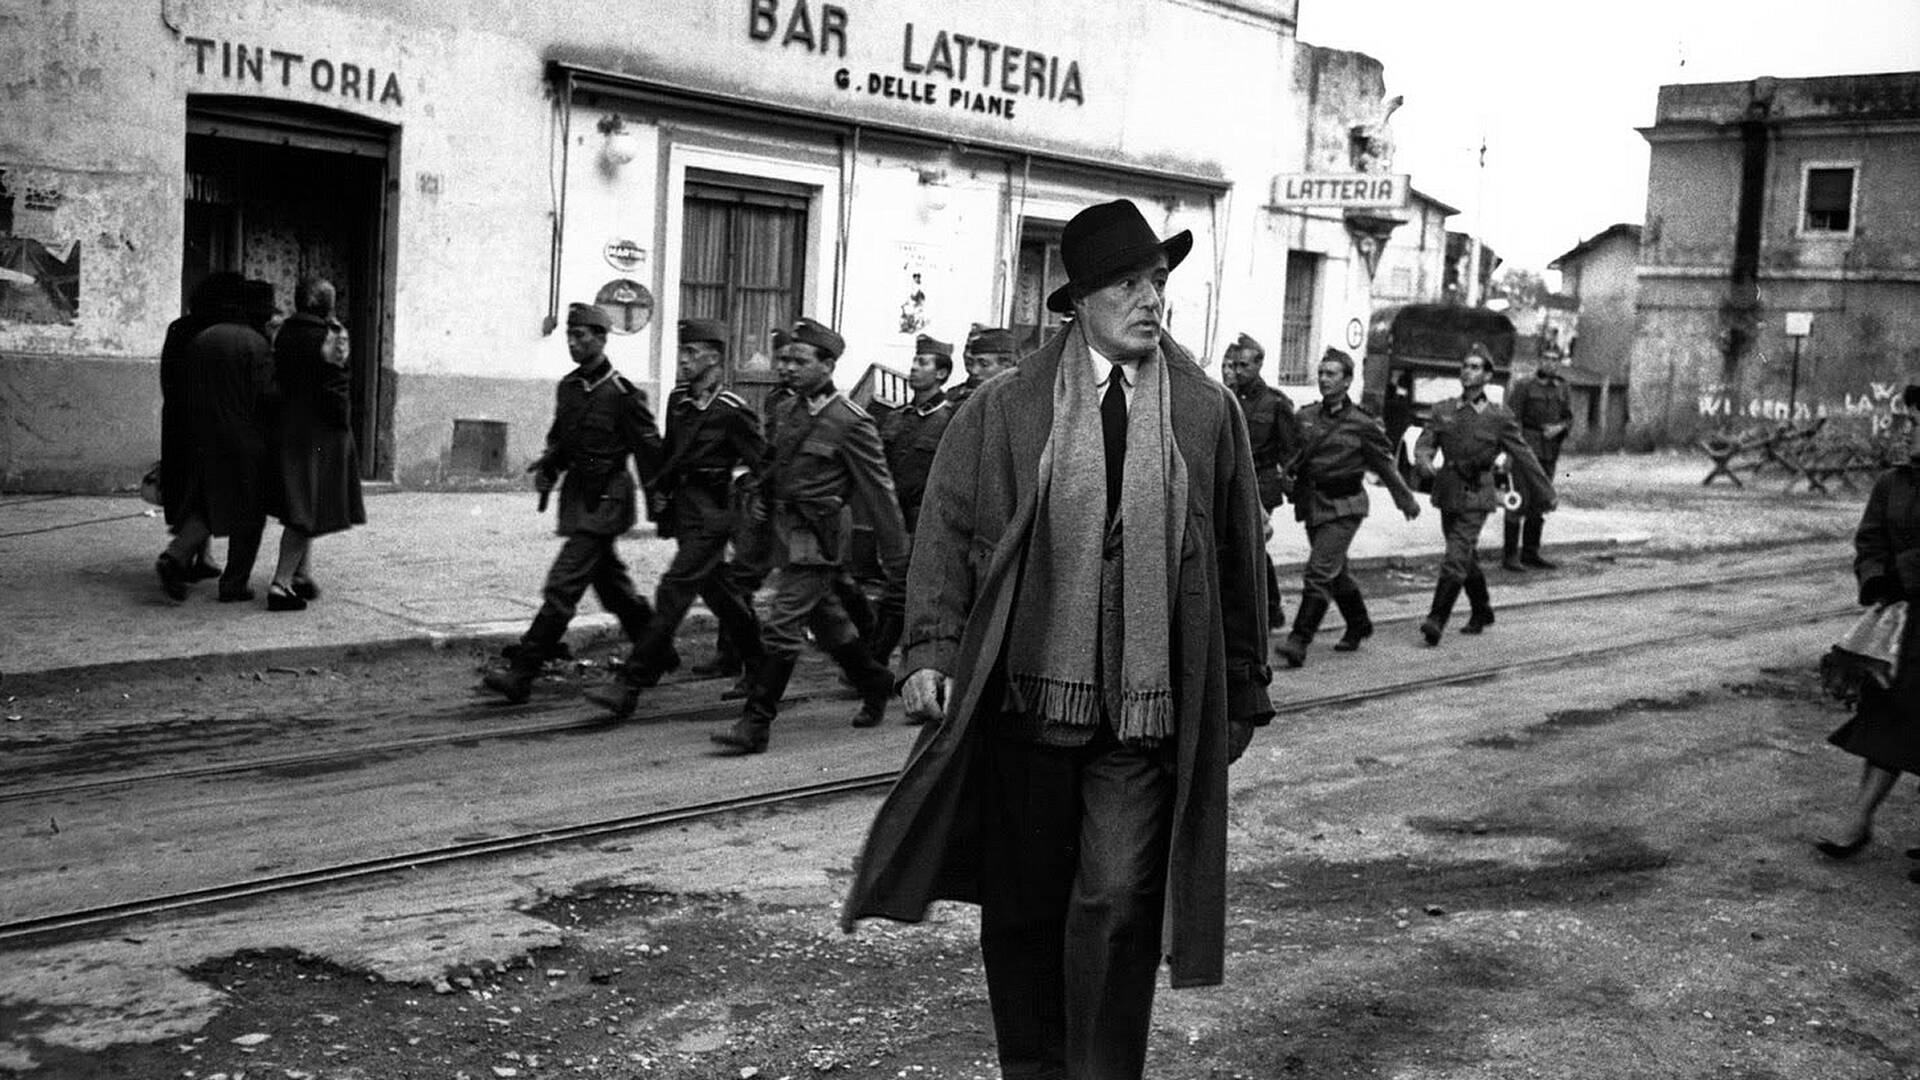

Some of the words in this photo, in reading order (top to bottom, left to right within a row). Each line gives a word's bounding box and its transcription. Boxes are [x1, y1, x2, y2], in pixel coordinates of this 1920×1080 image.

[185, 36, 402, 107] TINTORIA
[749, 0, 848, 58] BAR
[903, 23, 1085, 107] LATTERIA
[869, 73, 936, 105] DELLE
[950, 88, 1015, 120] PIANE
[1286, 180, 1393, 200] LATTERIA
